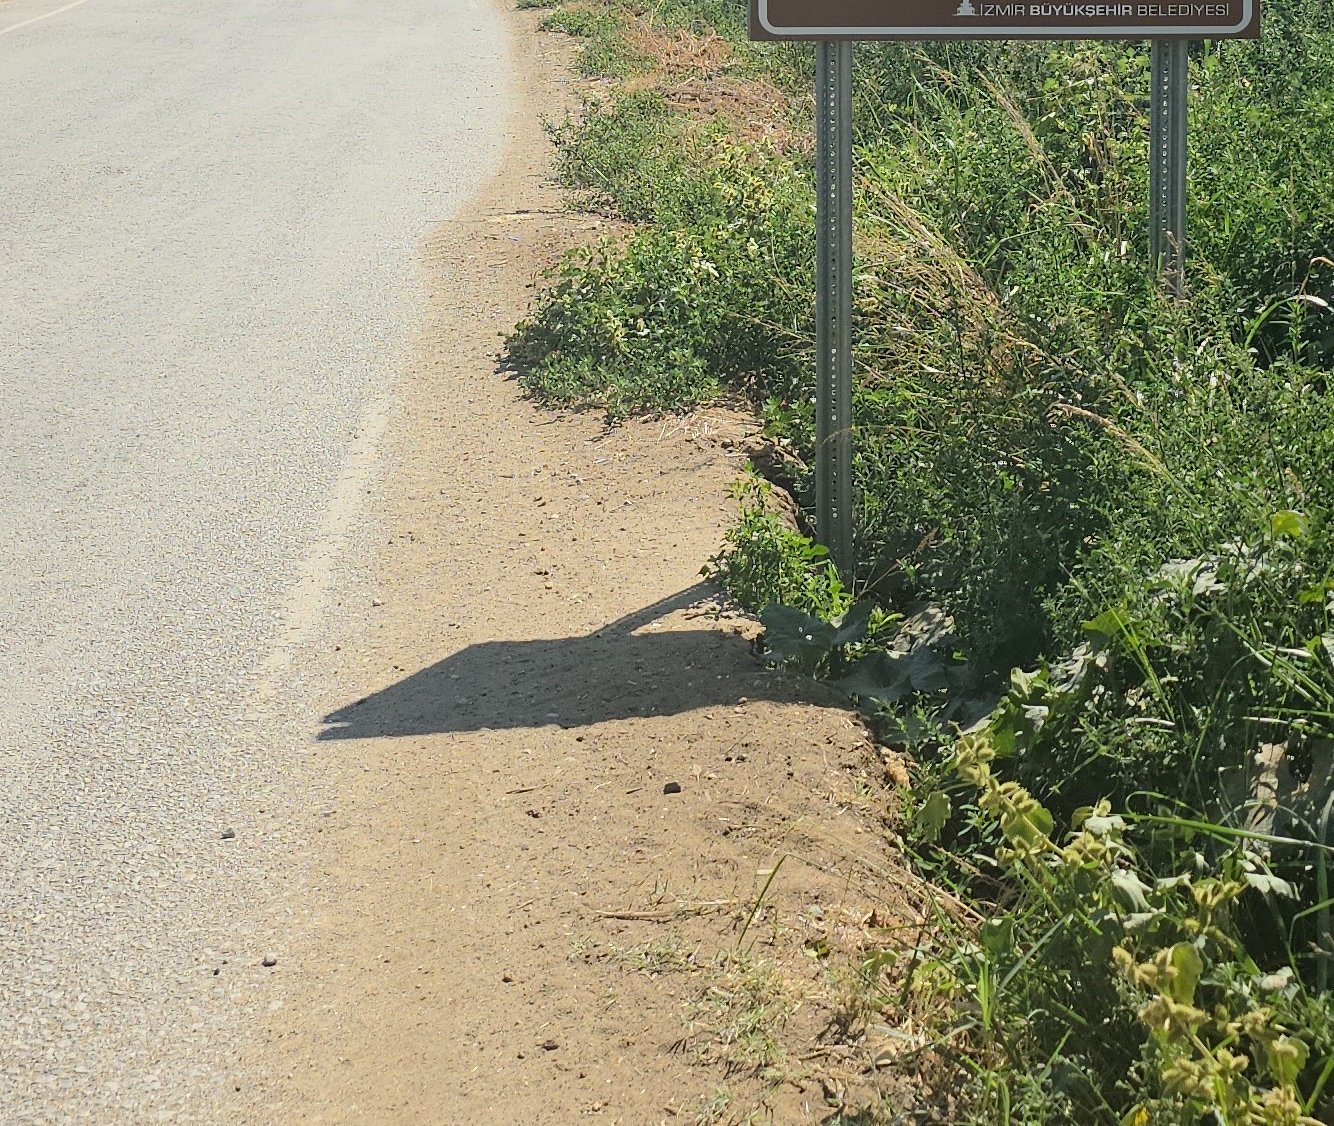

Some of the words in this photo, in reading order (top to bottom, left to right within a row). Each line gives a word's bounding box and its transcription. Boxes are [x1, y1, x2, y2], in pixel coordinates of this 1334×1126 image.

[980, 2, 1025, 17] İZMİR
[1030, 2, 1133, 18] BÜYÜKŞEHİR
[1137, 2, 1229, 17] BELEDİYESİ
